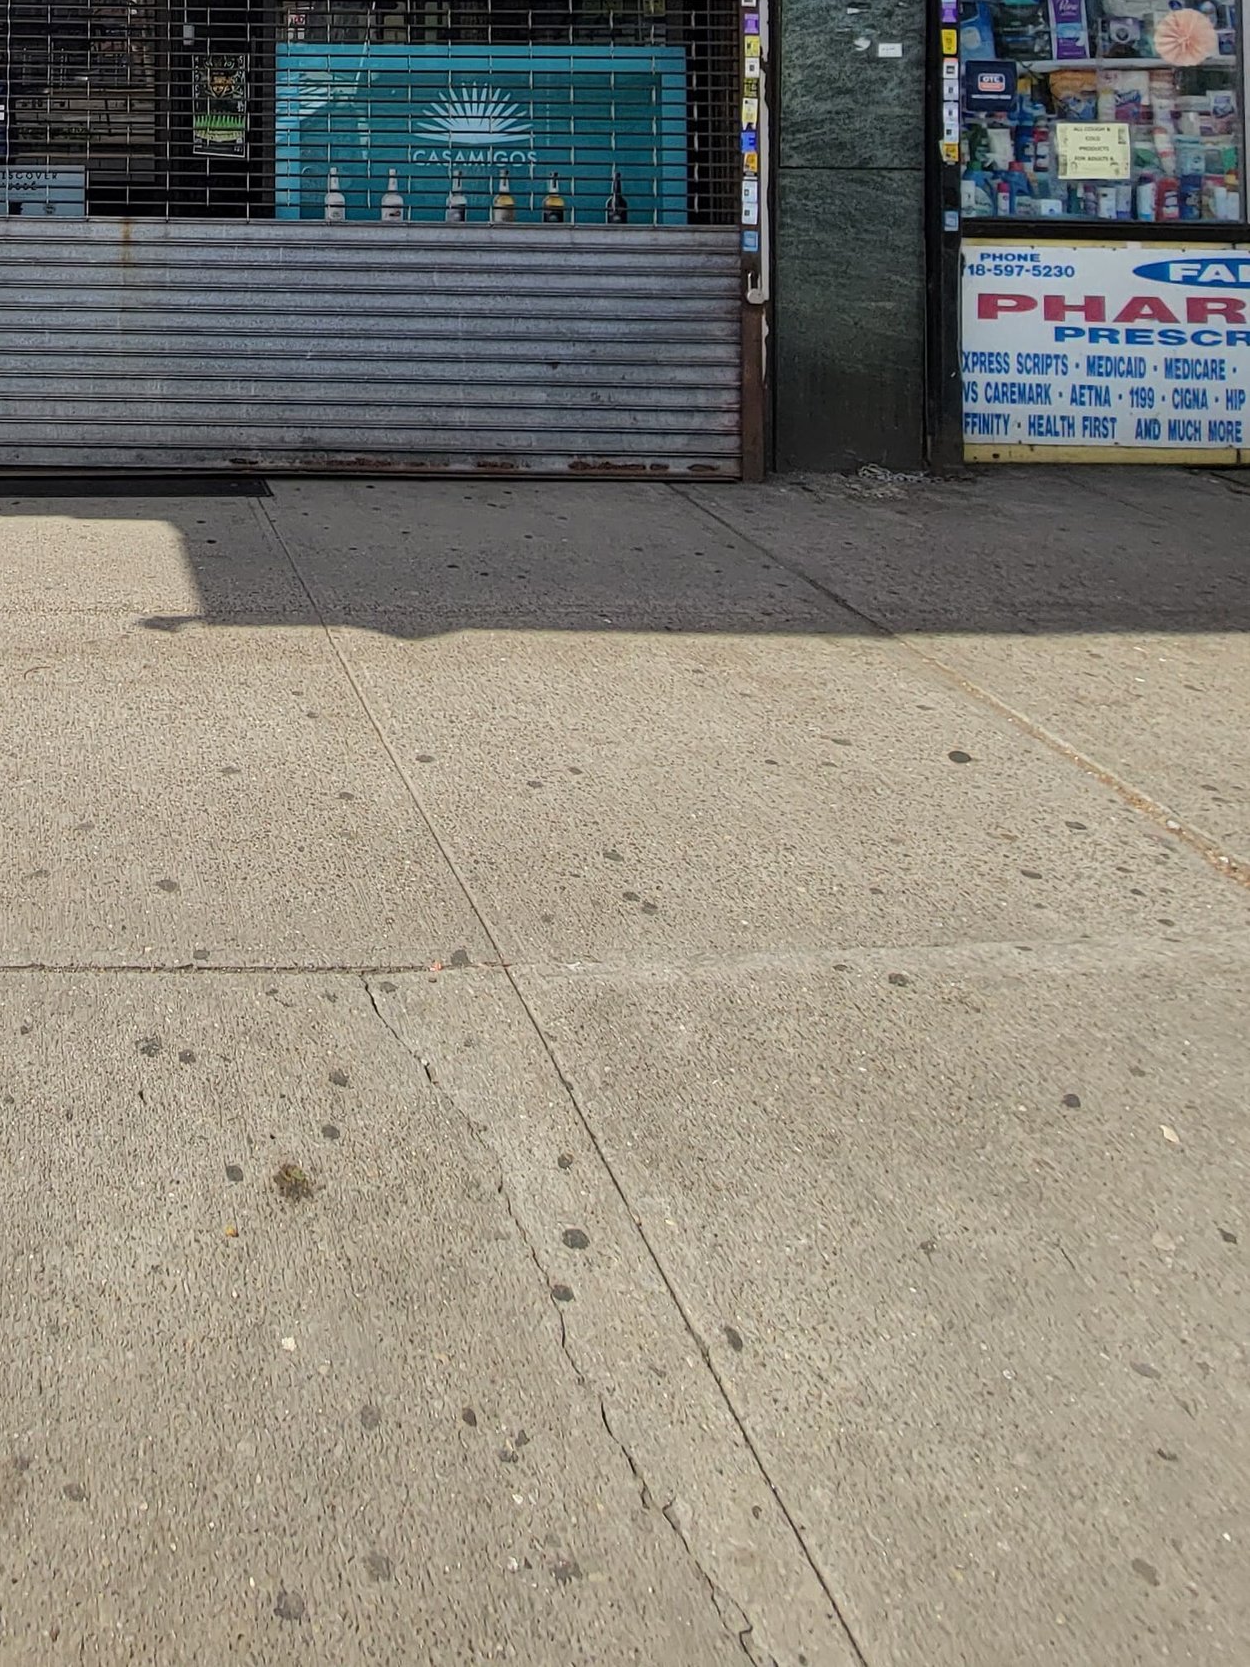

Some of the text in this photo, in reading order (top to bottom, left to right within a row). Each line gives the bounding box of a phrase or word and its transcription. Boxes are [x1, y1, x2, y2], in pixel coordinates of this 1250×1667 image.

[412, 149, 538, 167] CASAMIGOS
[962, 263, 1076, 278] 18-597-5230
[980, 253, 1041, 263] PHONE
[977, 293, 1248, 324] PHAR
[1016, 353, 1069, 376] SCRIPTS
[1086, 355, 1146, 379] MEDICAID
[1164, 357, 1226, 381] MEDICARE
[984, 382, 1052, 405] CAREMARK
[1070, 384, 1111, 407] AETNA
[1129, 387, 1155, 409] 1199
[1172, 388, 1208, 410] CIGNA
[1226, 389, 1245, 411] HIP
[1028, 414, 1075, 438] HEALTH
[1082, 416, 1117, 439] FIRST
[1135, 418, 1161, 441] AND
[1168, 419, 1201, 442] MUCH
[1208, 421, 1243, 443] MORE
